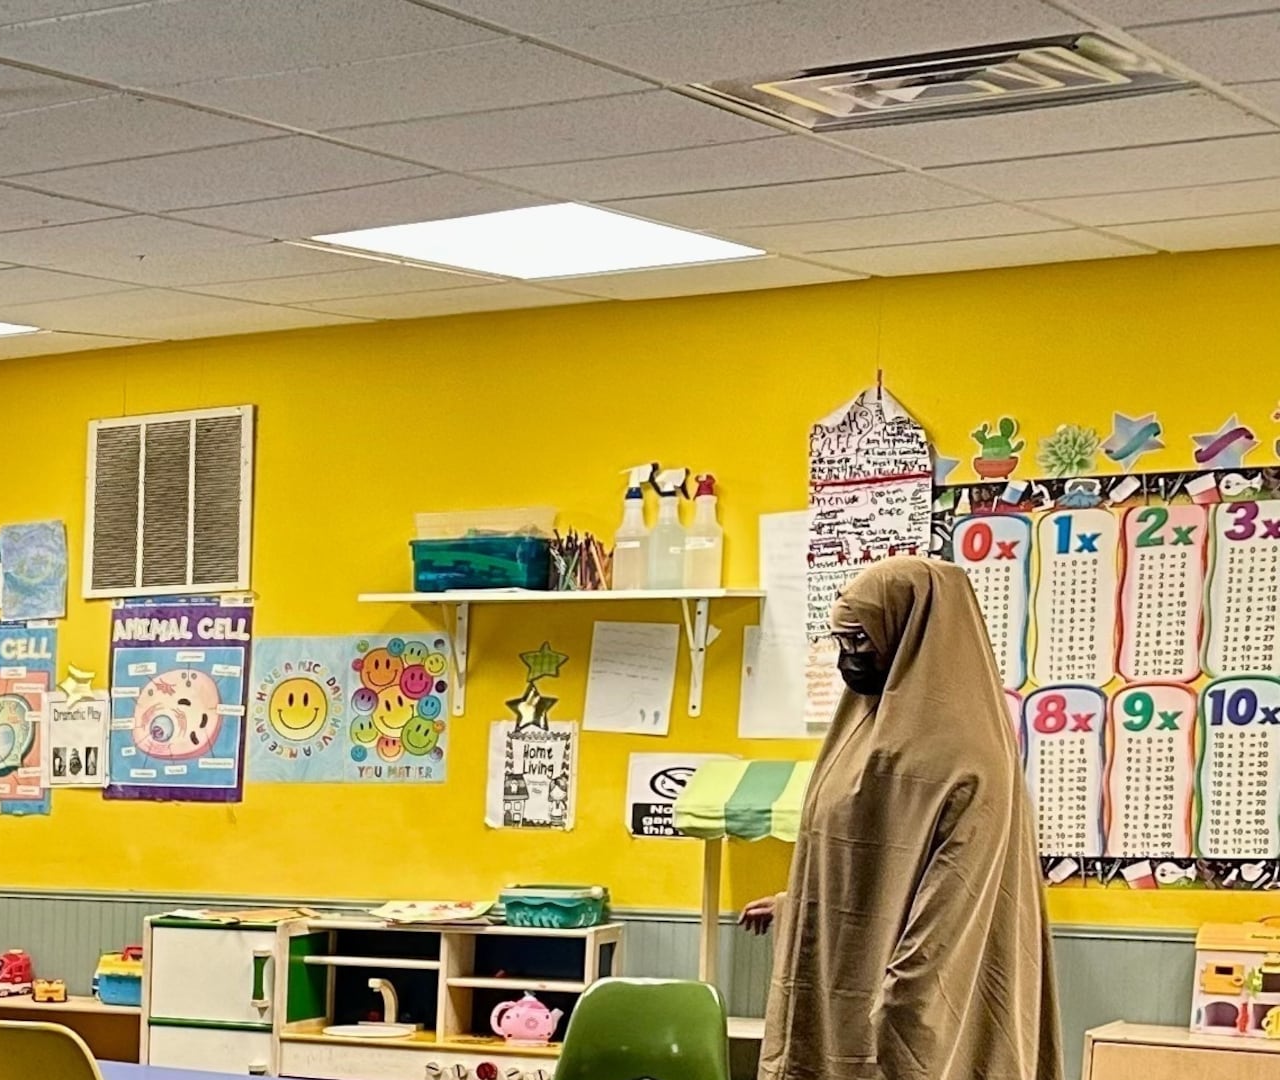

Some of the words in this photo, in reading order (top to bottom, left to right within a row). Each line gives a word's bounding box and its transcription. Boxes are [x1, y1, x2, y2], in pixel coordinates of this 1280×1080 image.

[1053, 514, 1102, 555] 1x
[1135, 506, 1197, 548] 2x
[962, 522, 1020, 562] 0x
[113, 616, 193, 642] ANIMAL
[197, 616, 251, 641] CELL
[0, 637, 52, 660] CELL
[53, 708, 86, 721] Dramatic
[1033, 694, 1097, 734] 8x
[1122, 691, 1183, 732] 9x
[523, 744, 553, 760] Home
[357, 765, 382, 778] YOU
[523, 762, 554, 780] Living
[643, 825, 674, 835] this
